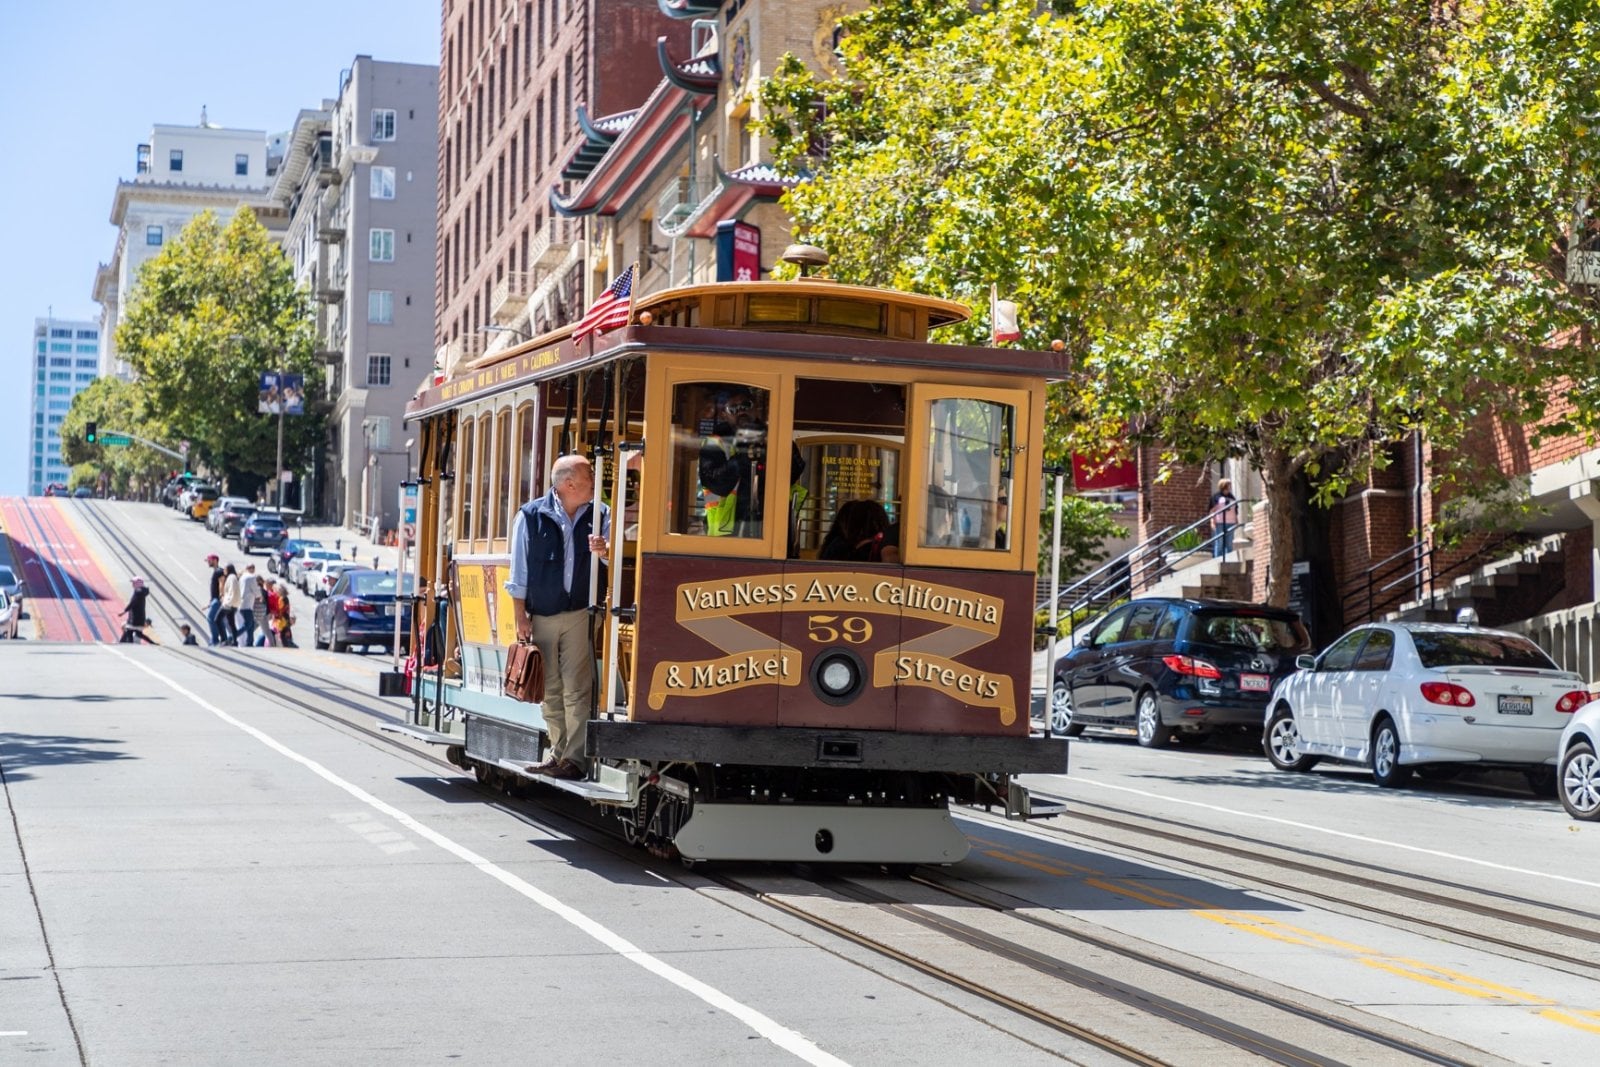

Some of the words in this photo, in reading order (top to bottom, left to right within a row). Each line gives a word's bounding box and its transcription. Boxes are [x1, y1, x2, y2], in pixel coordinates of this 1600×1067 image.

[823, 456, 837, 465] FARE
[853, 457, 866, 466] ONE
[868, 458, 880, 467] WAY
[683, 587, 730, 611] Van
[732, 581, 798, 606] Ness
[873, 581, 998, 625] California
[807, 615, 874, 644] 59
[666, 664, 686, 688] &
[690, 655, 790, 689] Market
[895, 656, 1000, 699] Streets
